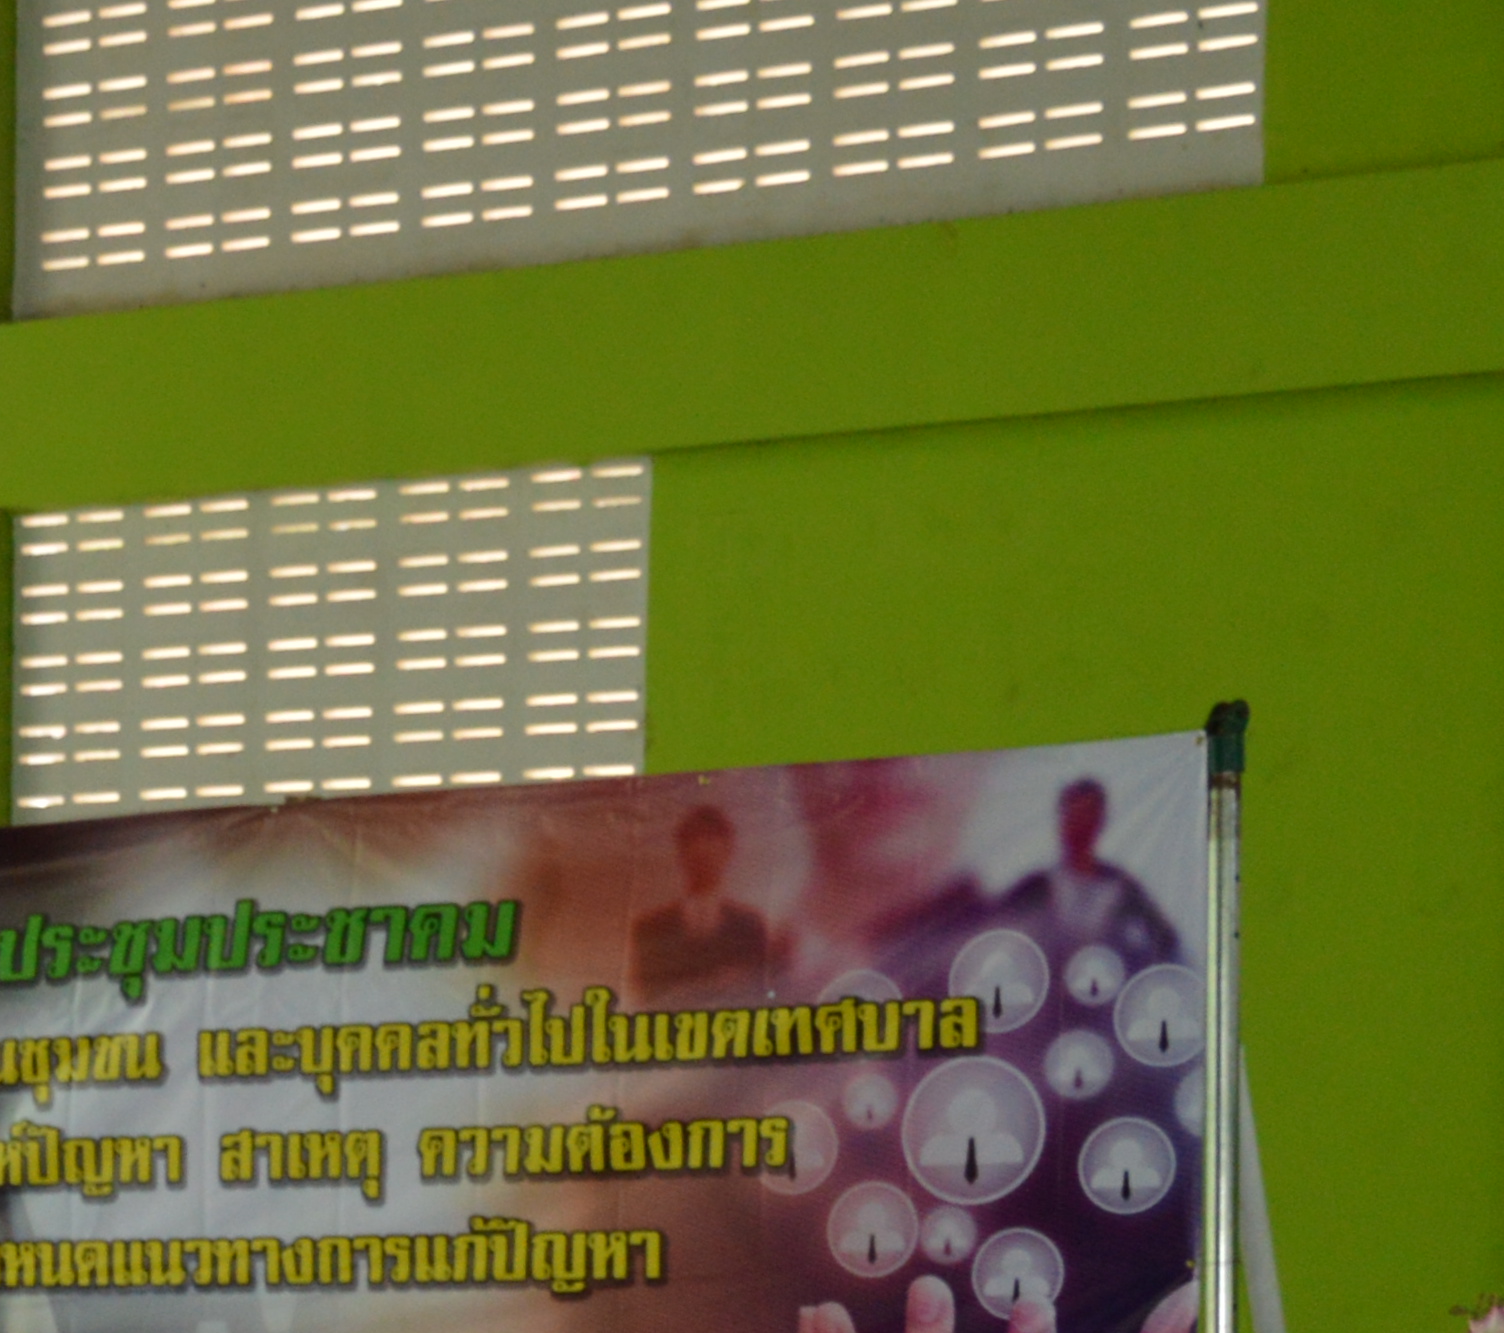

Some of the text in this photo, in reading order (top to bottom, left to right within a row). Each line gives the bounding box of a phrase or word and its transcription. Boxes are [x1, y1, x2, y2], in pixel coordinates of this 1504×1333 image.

[198, 982, 980, 1096] และบุคคลทั่วไปในเขตเทศบาล
[219, 1128, 383, 1200] สาเหตุ
[418, 1104, 791, 1178] ความต้องการ
